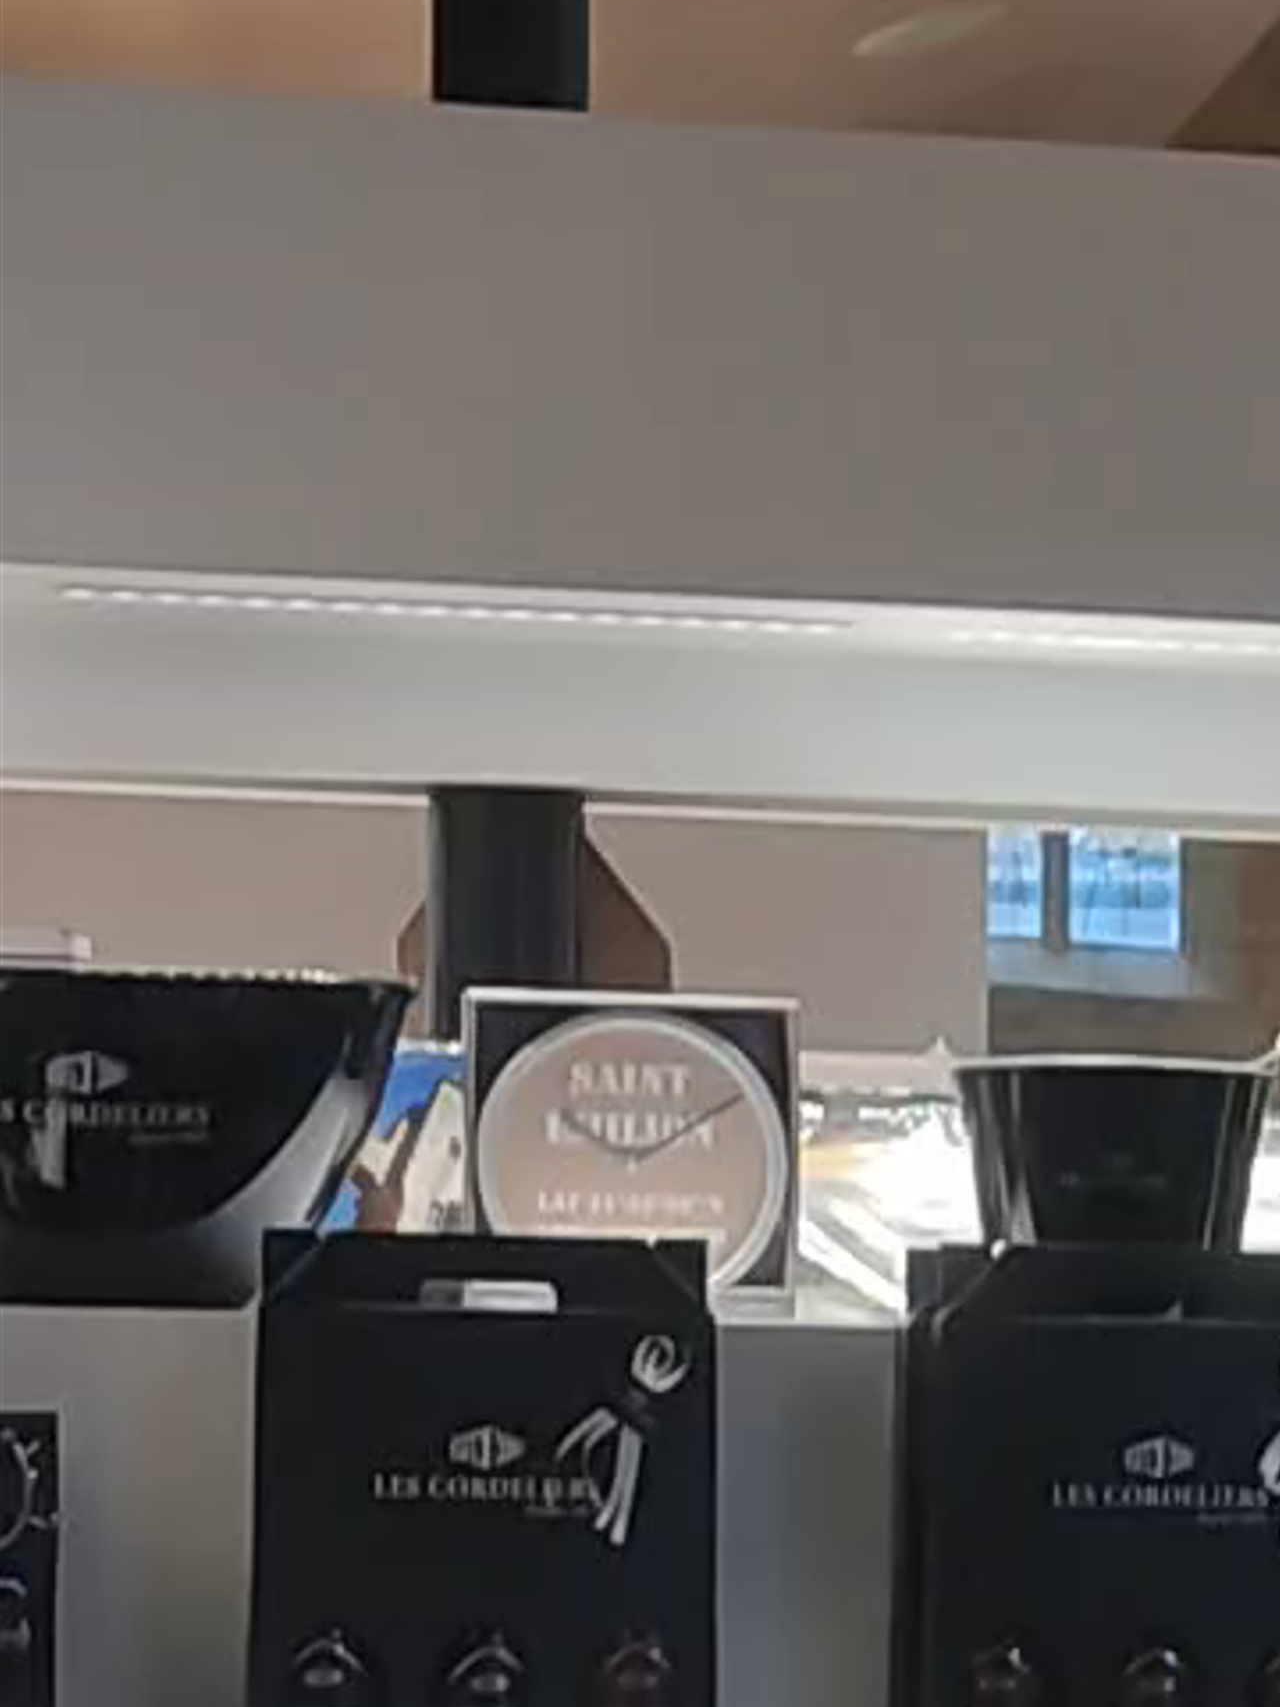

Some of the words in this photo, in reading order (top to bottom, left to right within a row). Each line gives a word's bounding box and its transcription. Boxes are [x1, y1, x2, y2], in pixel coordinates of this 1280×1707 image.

[22, 1099, 210, 1125] CRDELIERS
[374, 1474, 421, 1500] LES
[1053, 1481, 1097, 1507] LES
